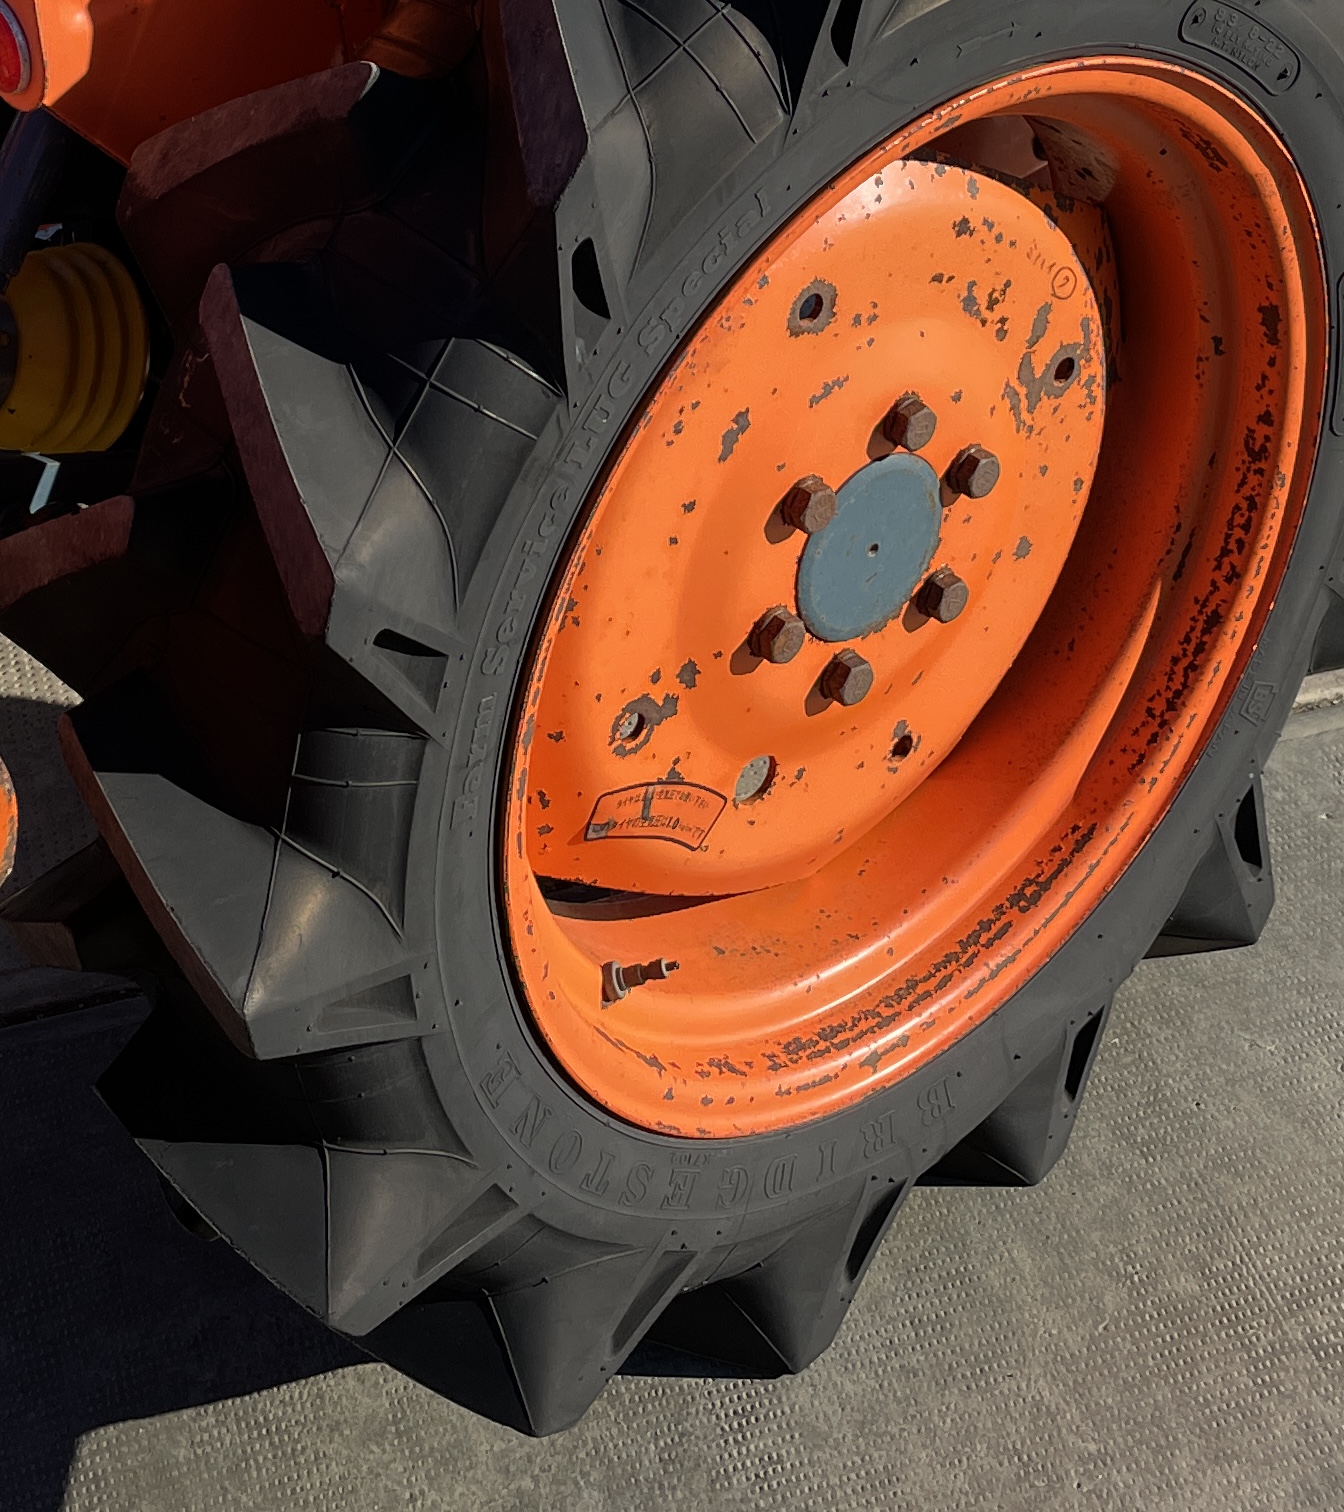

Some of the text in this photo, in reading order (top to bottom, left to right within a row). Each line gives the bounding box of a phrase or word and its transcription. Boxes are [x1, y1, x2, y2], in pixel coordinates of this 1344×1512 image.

[449, 186, 772, 832] Farm Service LUG Special
[478, 1050, 957, 1212] BRIDGESTONE
